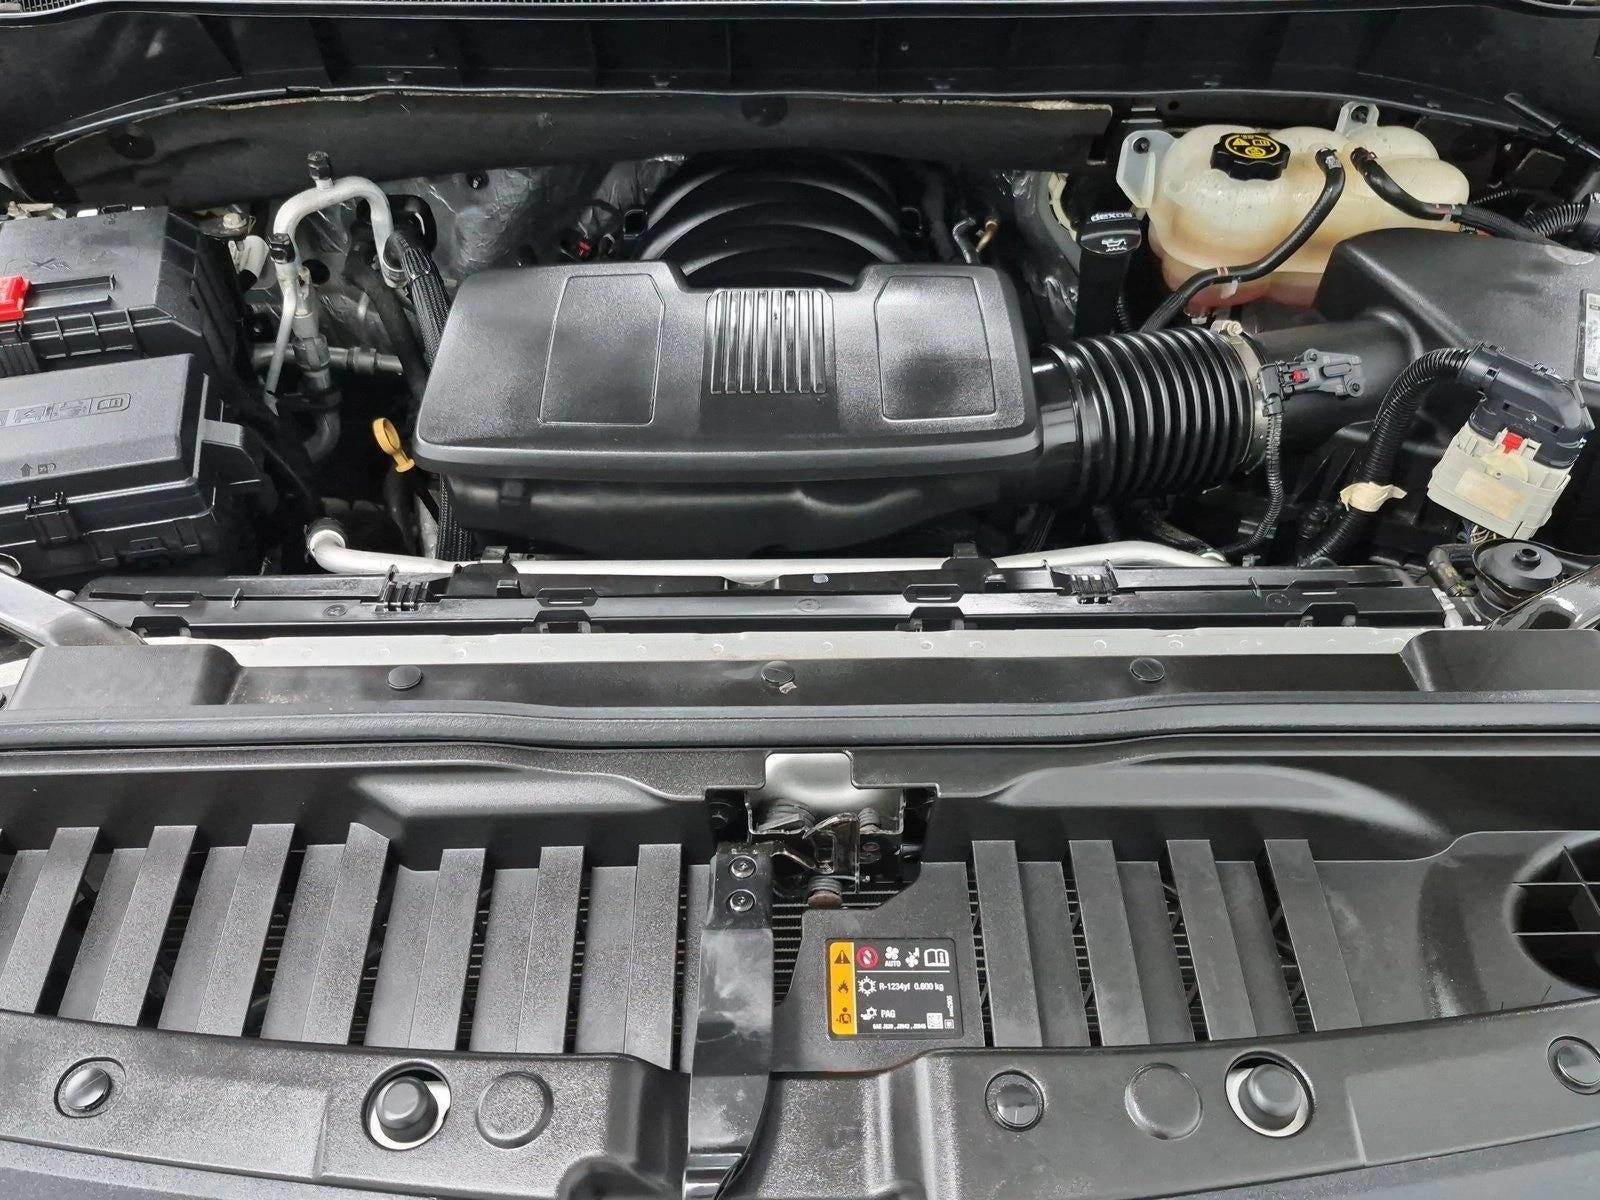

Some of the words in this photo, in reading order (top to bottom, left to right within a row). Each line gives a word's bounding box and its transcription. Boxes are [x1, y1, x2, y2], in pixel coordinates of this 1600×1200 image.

[1091, 212, 1132, 222] dexos
[934, 982, 944, 992] kg
[881, 1009, 896, 1018] PAG
